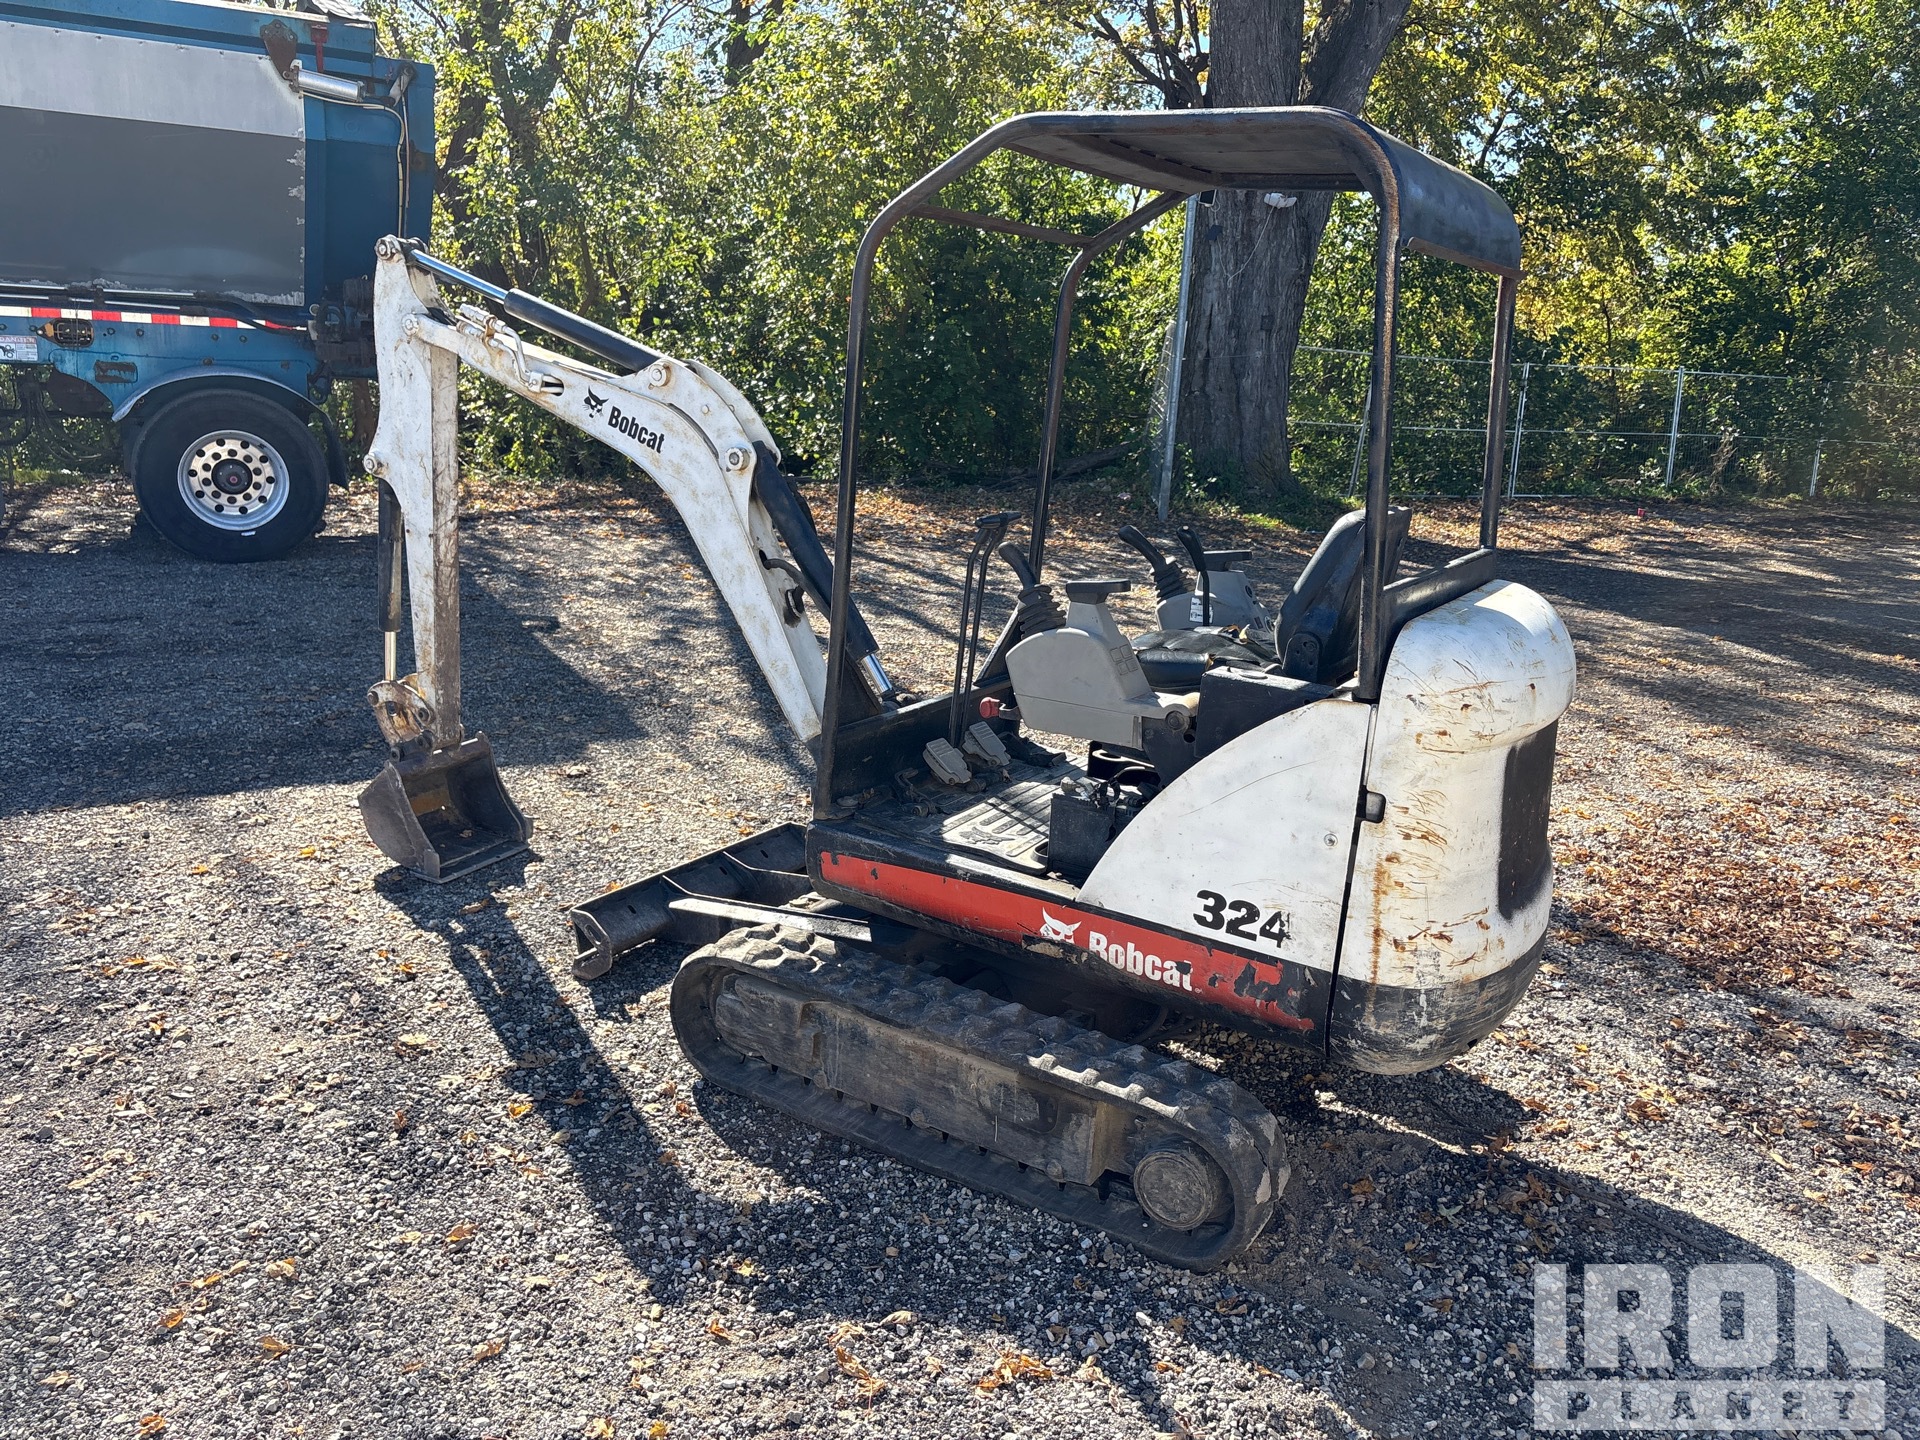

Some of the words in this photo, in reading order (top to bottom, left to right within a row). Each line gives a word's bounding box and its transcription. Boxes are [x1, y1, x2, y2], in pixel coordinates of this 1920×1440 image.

[607, 405, 665, 454] Bobcat
[1193, 889, 1291, 948] 324
[1088, 930, 1193, 992] Bobcat
